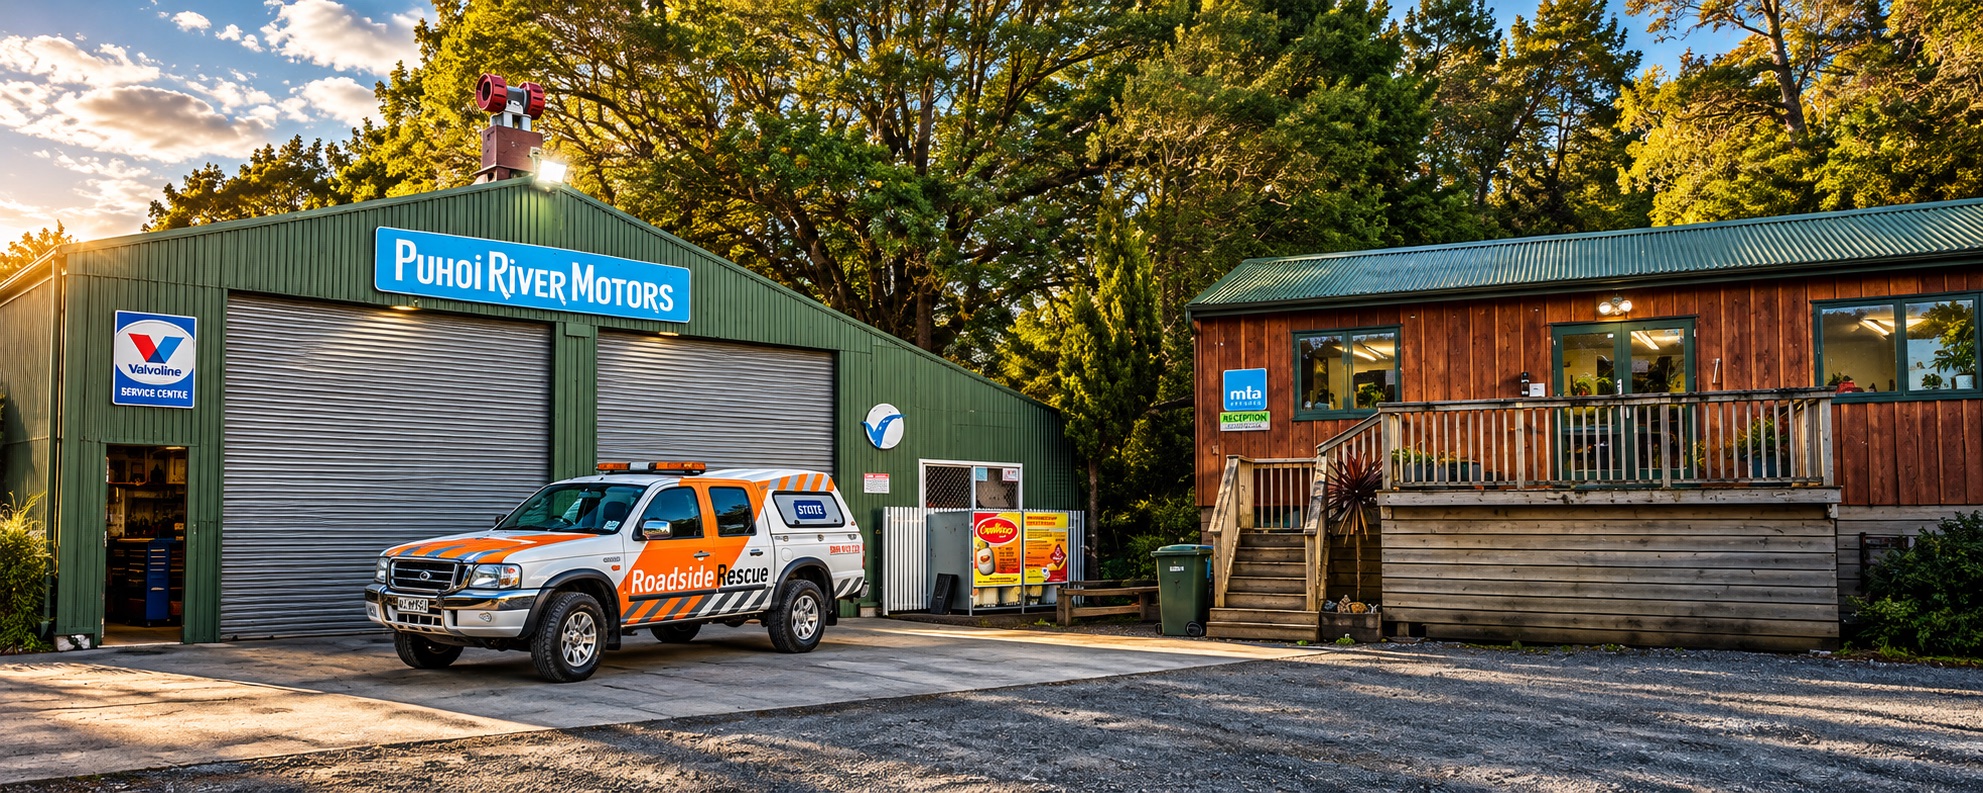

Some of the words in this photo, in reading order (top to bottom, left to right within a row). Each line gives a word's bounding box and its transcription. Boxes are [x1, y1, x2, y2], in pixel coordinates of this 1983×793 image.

[571, 262, 674, 314] MOTORS
[128, 363, 182, 377] Valvoline
[121, 387, 155, 398] SERVICE
[1230, 385, 1262, 400] mta
[1222, 413, 1267, 422] RECEPTION
[631, 565, 714, 594] Roadside
[716, 563, 769, 587] Rescue
